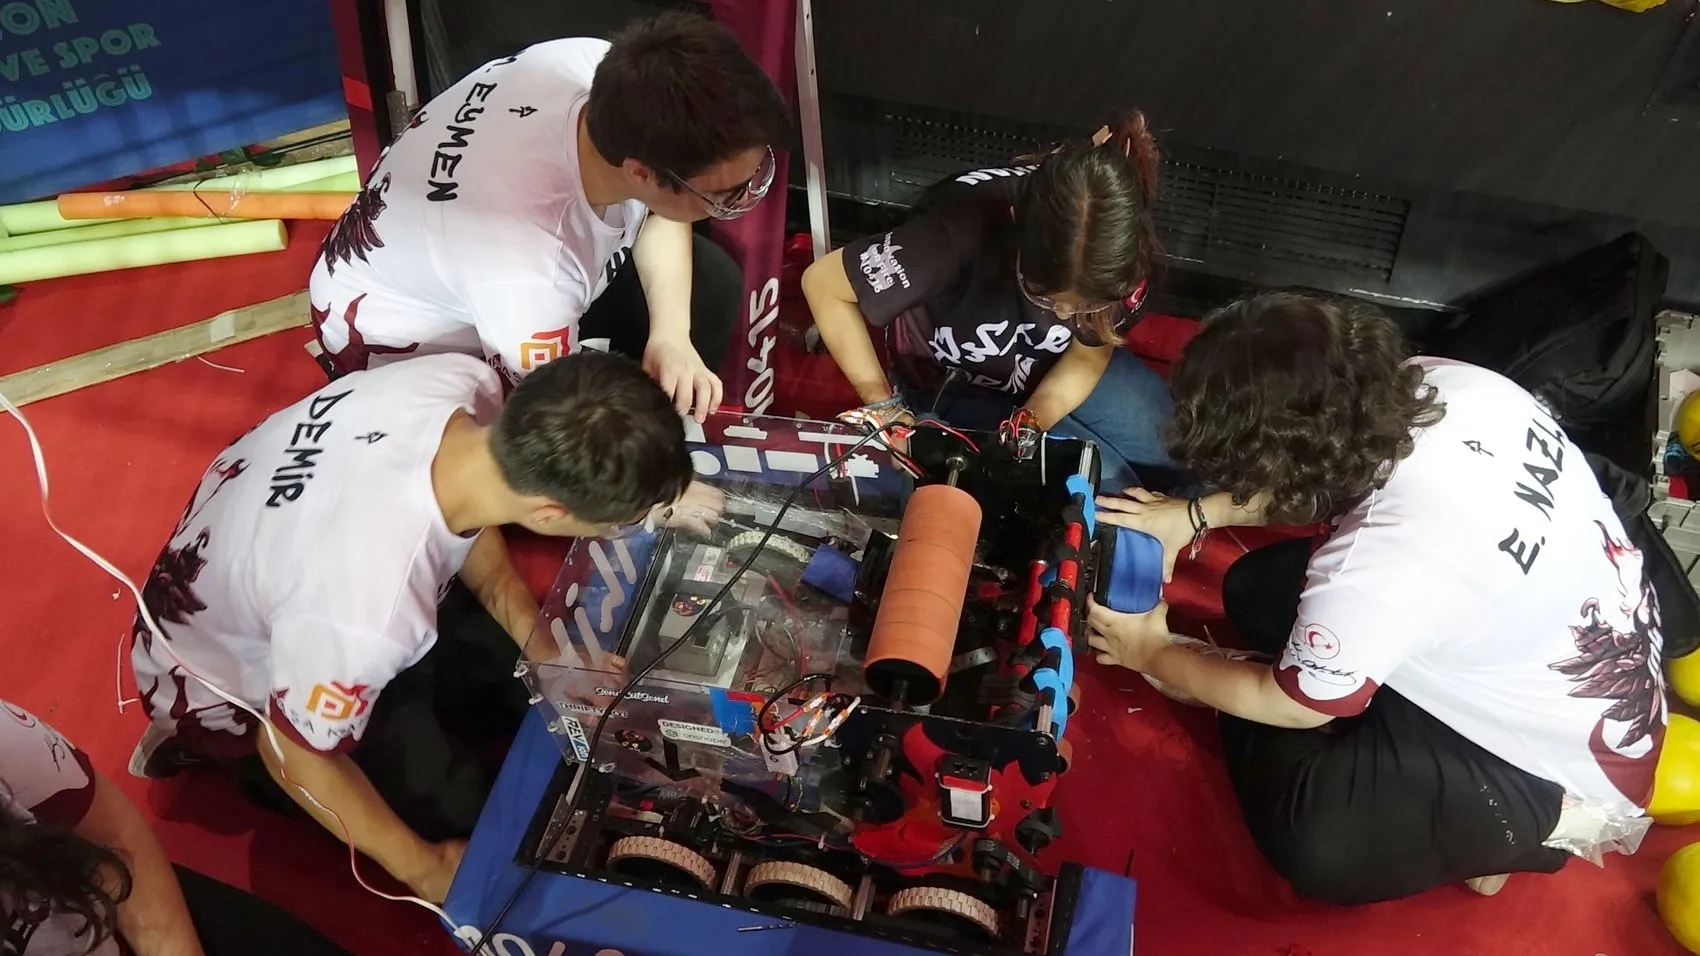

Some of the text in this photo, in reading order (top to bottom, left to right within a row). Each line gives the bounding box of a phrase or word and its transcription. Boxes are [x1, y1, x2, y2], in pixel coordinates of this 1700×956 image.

[0, 0, 78, 35] ON
[0, 22, 161, 81] VE SPOR
[0, 64, 152, 132] ÜRLÜĞÜ
[426, 82, 498, 202] EYMEN
[1498, 527, 1546, 576] E.
[662, 721, 714, 734] DESIGNED
